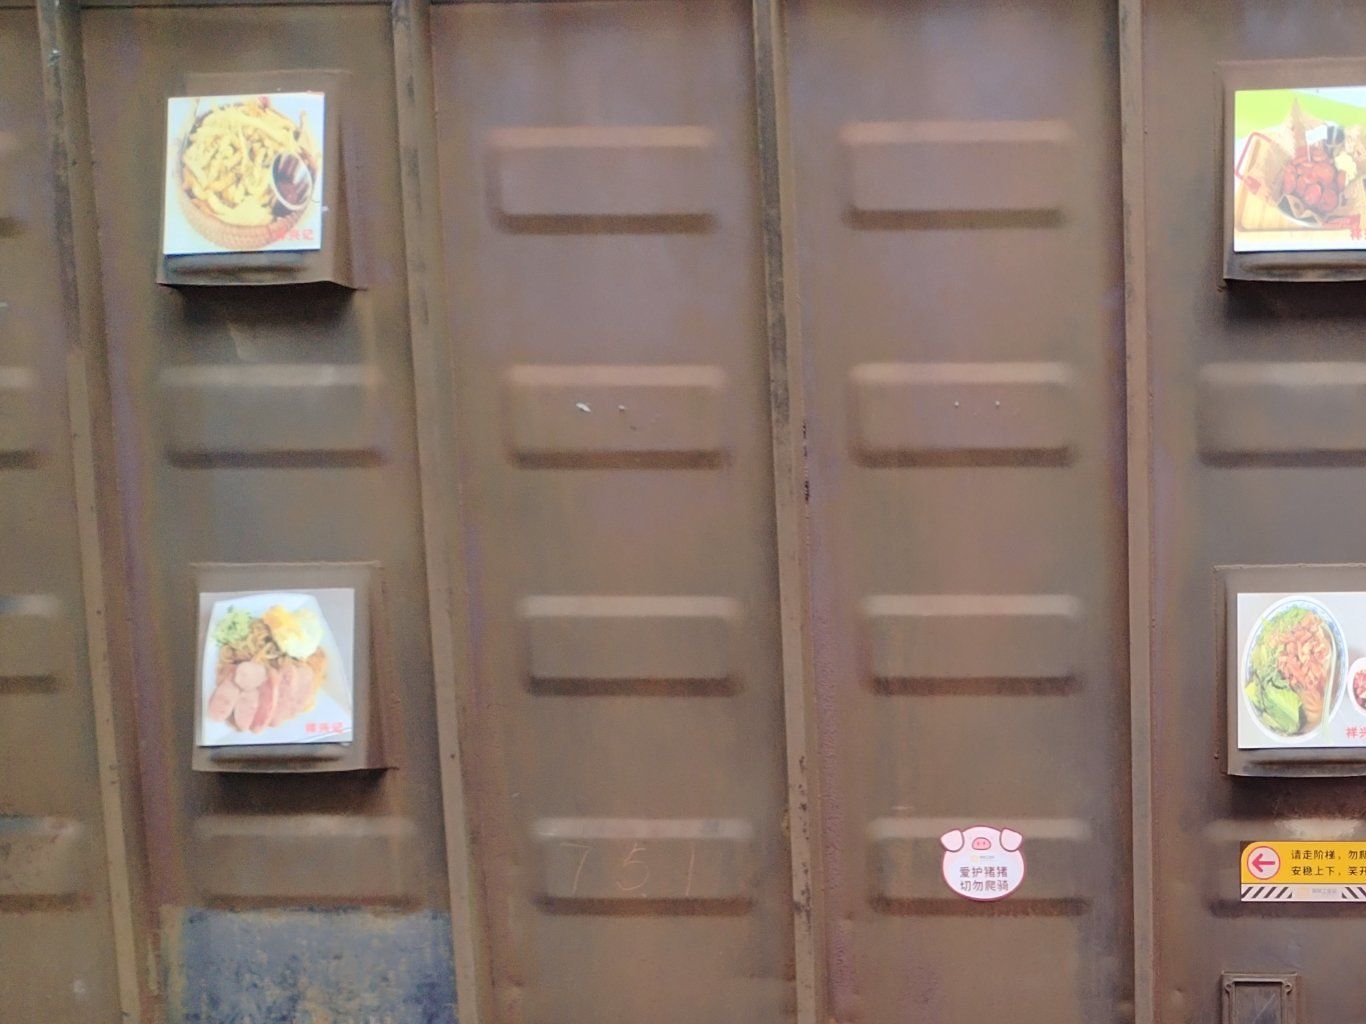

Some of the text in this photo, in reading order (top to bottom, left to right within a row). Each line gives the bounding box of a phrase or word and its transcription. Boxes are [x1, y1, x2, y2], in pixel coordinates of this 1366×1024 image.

[960, 866, 1008, 878] 爱护猪猪
[960, 880, 1009, 892] 切勿爬骑
